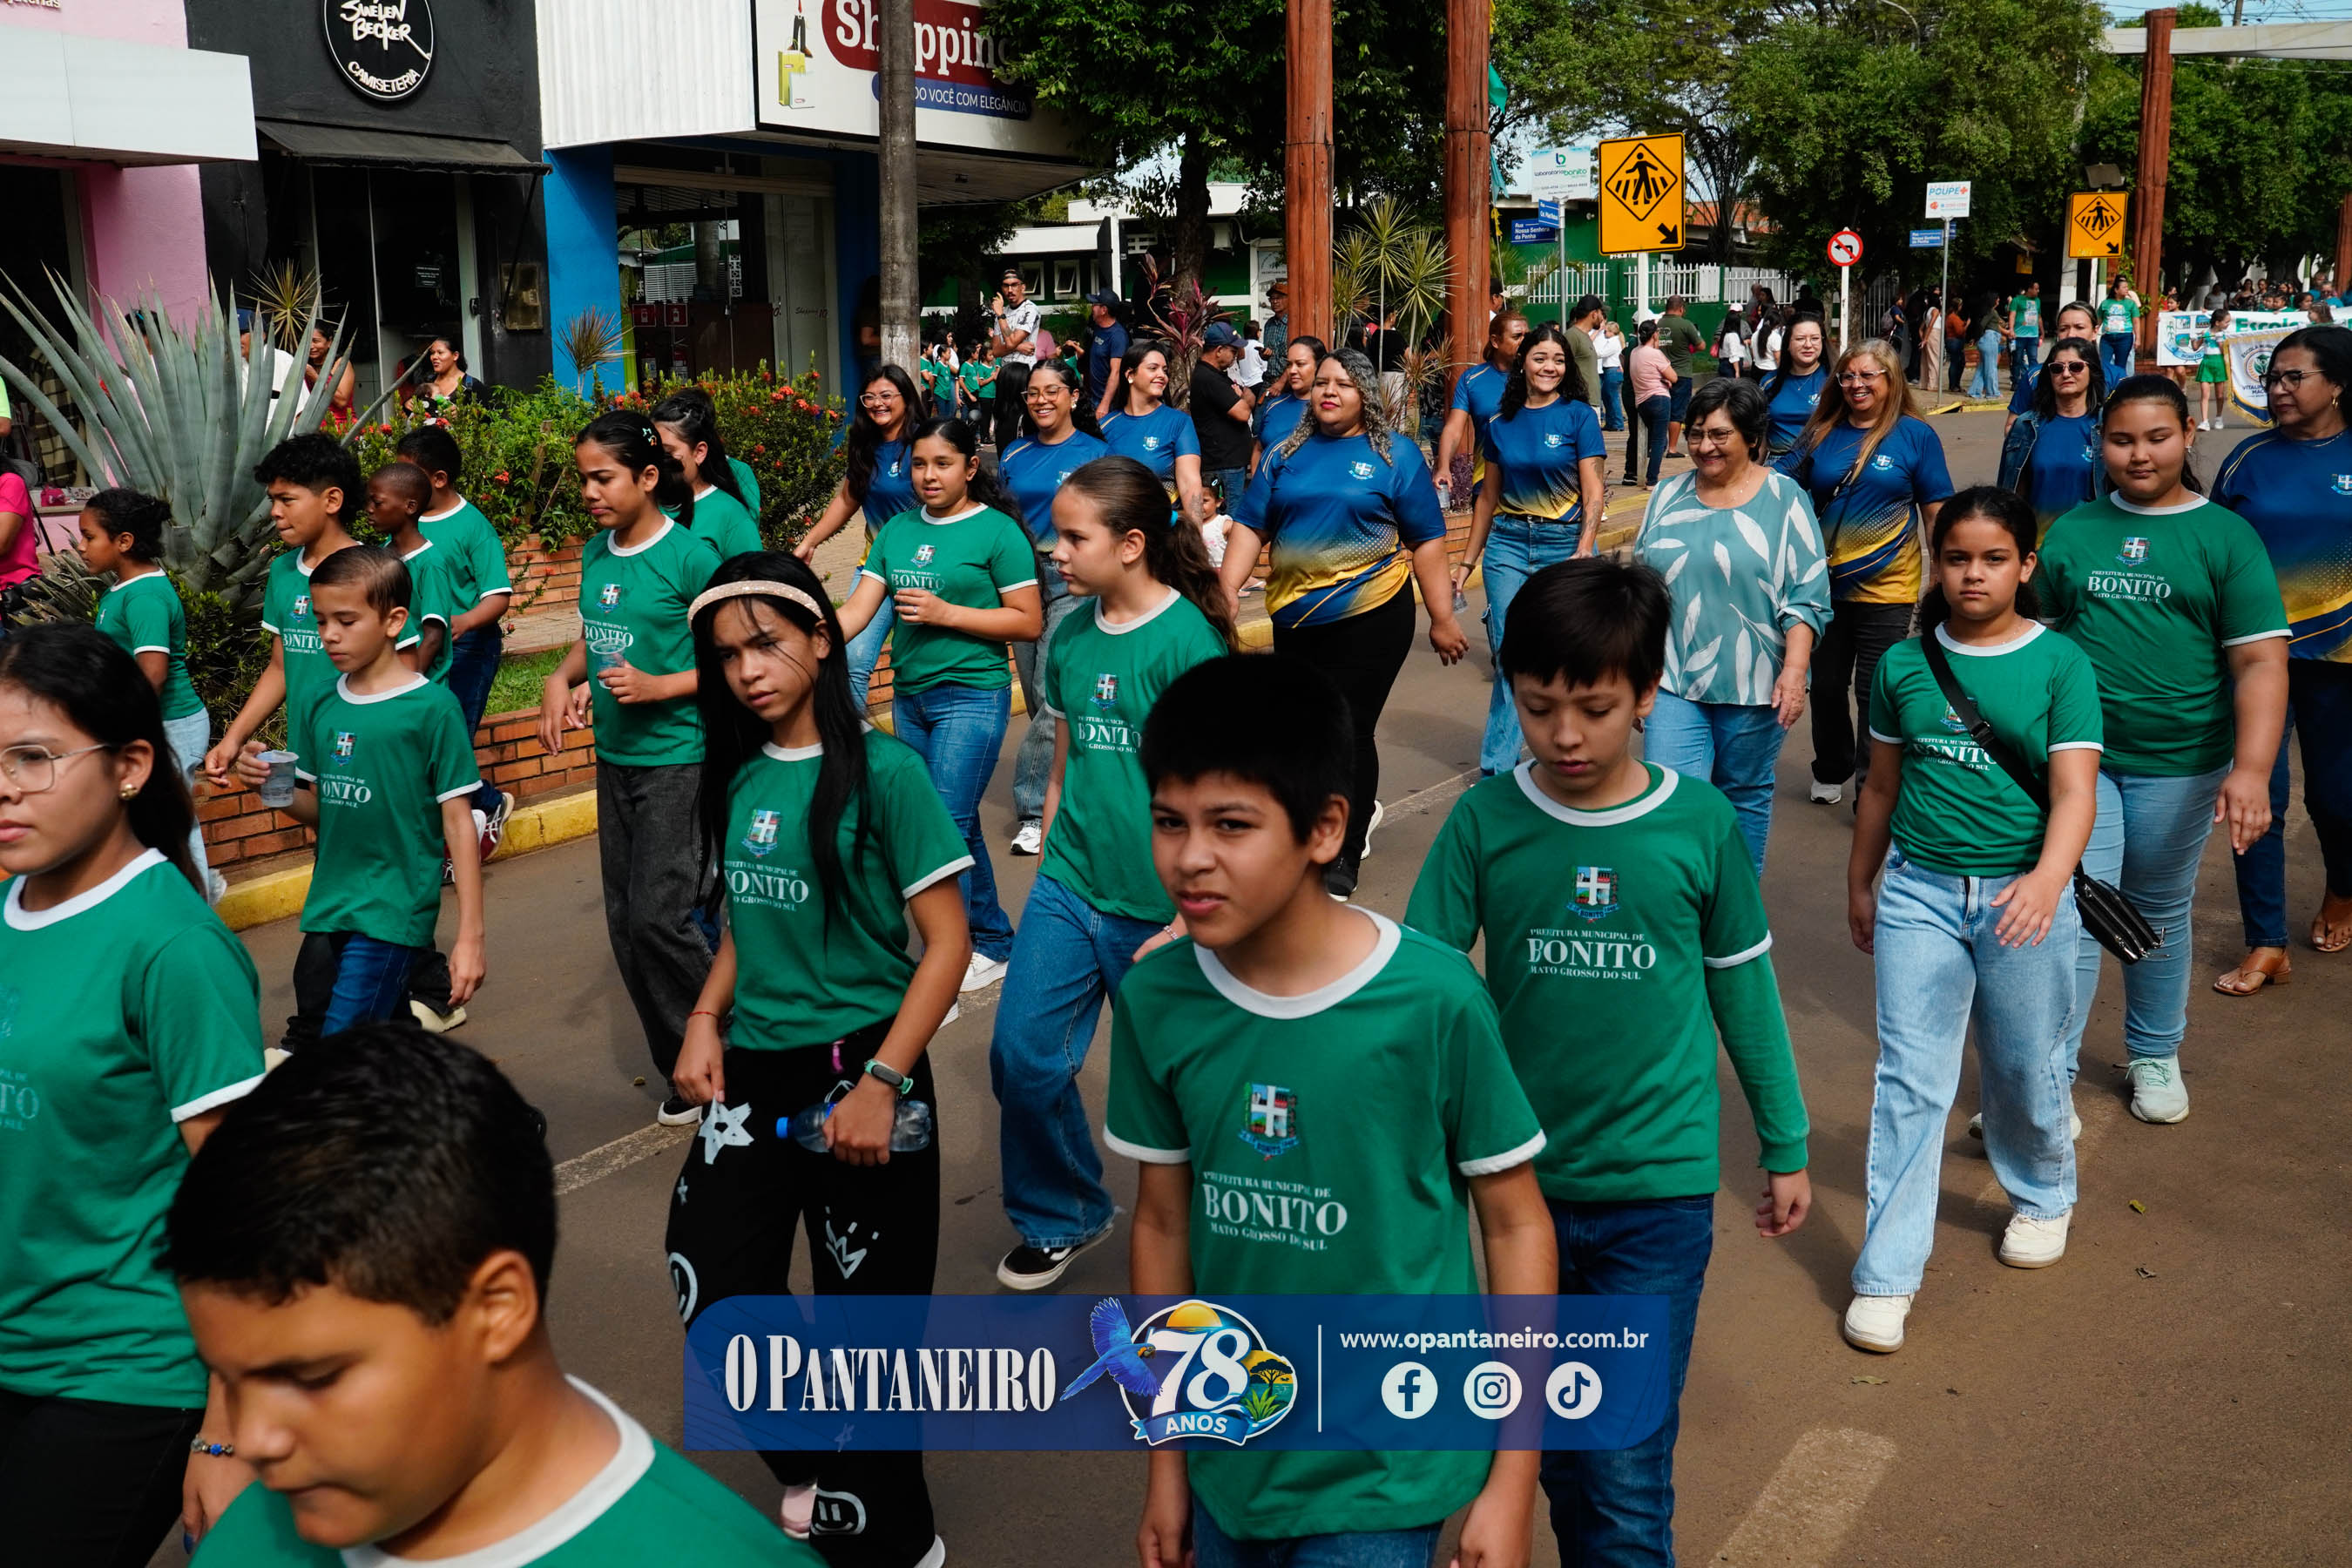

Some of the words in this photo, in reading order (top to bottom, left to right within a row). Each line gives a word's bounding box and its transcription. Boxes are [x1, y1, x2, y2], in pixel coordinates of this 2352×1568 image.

[352, 17, 430, 60] BECKER
[835, 0, 1017, 85] Shpping
[348, 61, 421, 92] CAMISETERIA
[929, 88, 955, 104] VOCÊ
[956, 92, 978, 107] COM
[980, 95, 1028, 113] ELEGÂNCIA
[891, 573, 946, 591] BONITO
[2087, 576, 2172, 598] BONITO
[1581, 929, 1630, 941] MUNICIPAL
[1632, 933, 1645, 942] DE
[1526, 937, 1657, 970] BONITO
[1559, 967, 1599, 978] GROSSO
[1602, 970, 1619, 980] DO
[1621, 971, 1642, 981] SUL
[1314, 1187, 1331, 1199] DE
[1201, 1183, 1348, 1236] BONITO
[1241, 1227, 1287, 1243] GROSSO
[1302, 1238, 1328, 1252] SUL
